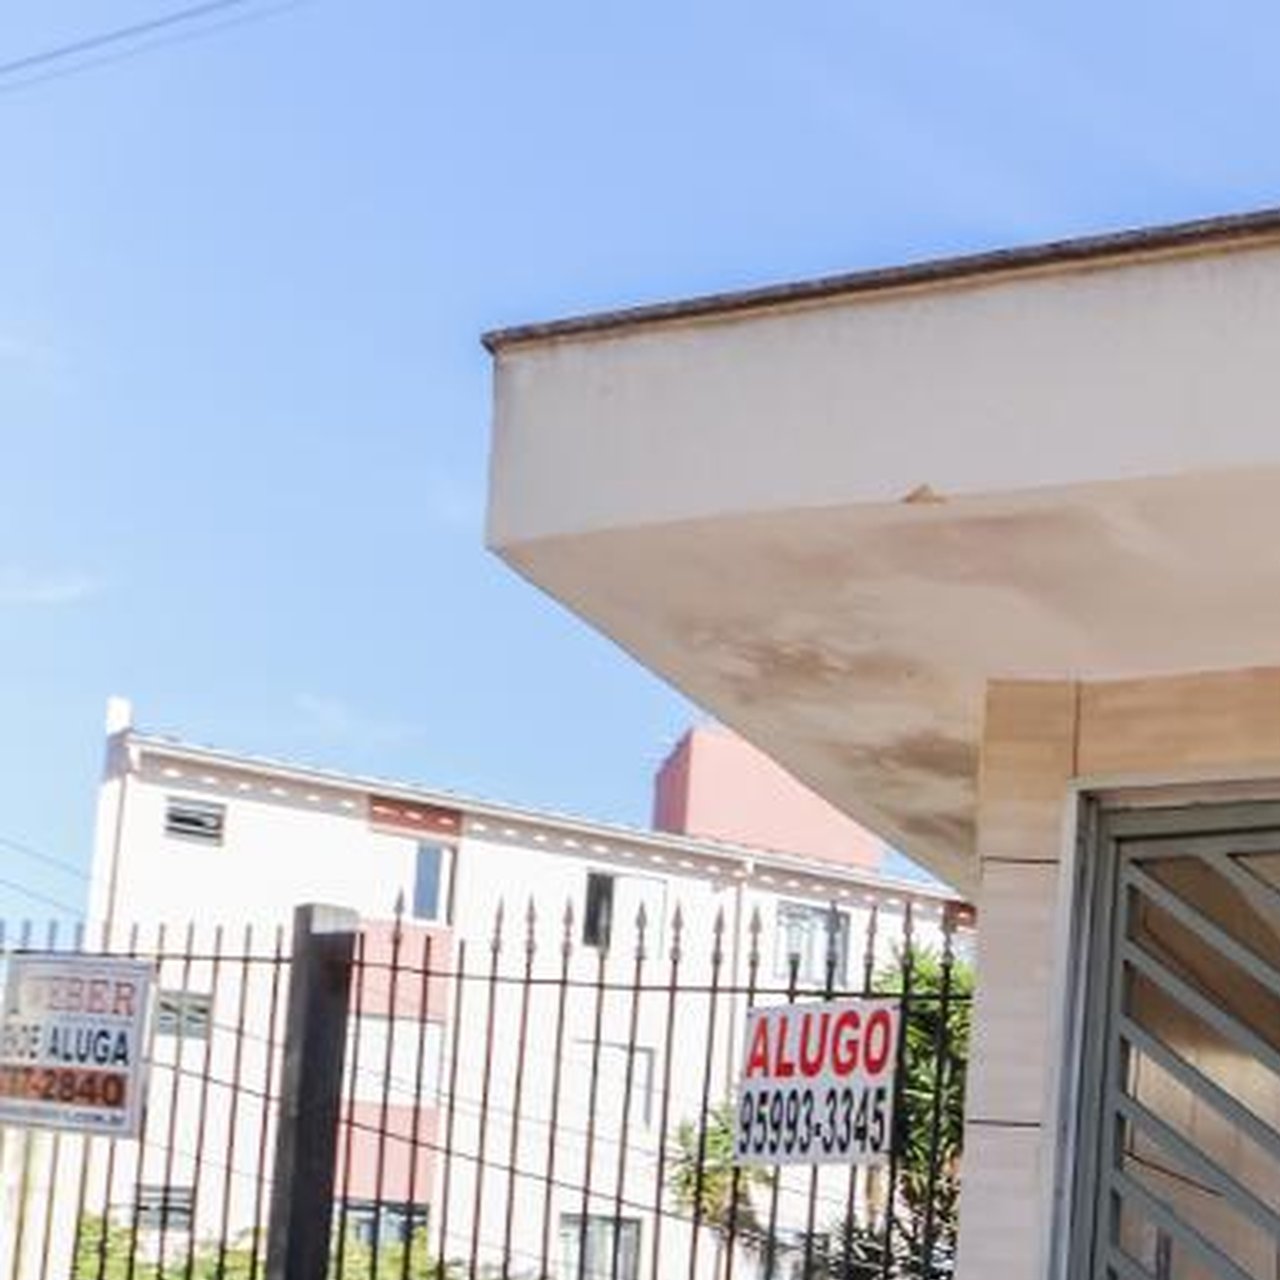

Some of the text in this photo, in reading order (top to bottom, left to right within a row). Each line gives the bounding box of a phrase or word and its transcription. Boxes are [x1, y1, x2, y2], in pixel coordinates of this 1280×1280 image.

[46, 1024, 130, 1066] ALUGA
[745, 1009, 892, 1078] ALUGO
[738, 1087, 887, 1154] 95993-3345
